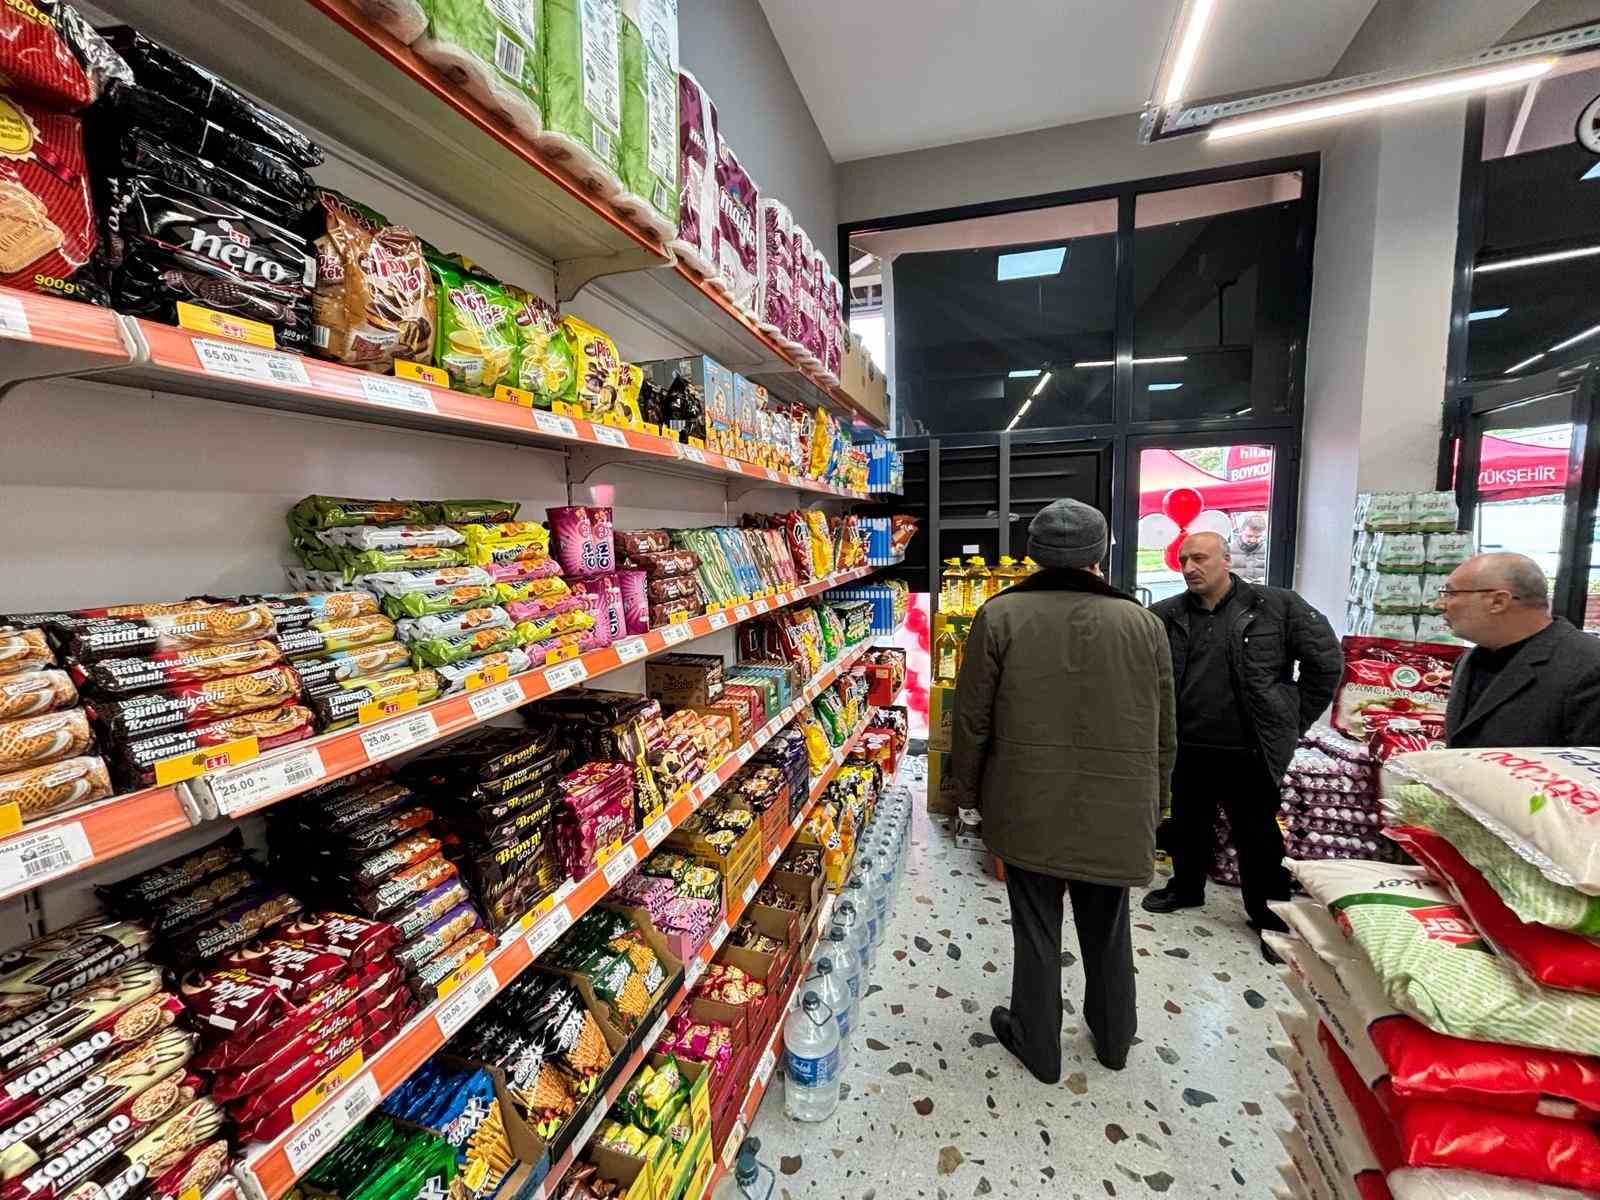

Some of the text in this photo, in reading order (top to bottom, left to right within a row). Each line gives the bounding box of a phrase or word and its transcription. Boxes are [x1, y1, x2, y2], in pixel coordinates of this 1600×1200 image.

[190, 227, 284, 283] nero
[112, 660, 146, 676] ütlü
[117, 670, 165, 687] remalı
[123, 705, 169, 721] Sütlü
[124, 711, 185, 732] Kremalı
[136, 740, 196, 764] Kremalı
[204, 752, 230, 770] ETİ
[222, 777, 256, 797] 25.00
[5, 1030, 113, 1100] KOMBO
[0, 1075, 106, 1149] KOMBO
[293, 1126, 323, 1157] 36.00
[22, 1114, 131, 1193] KOMBO
